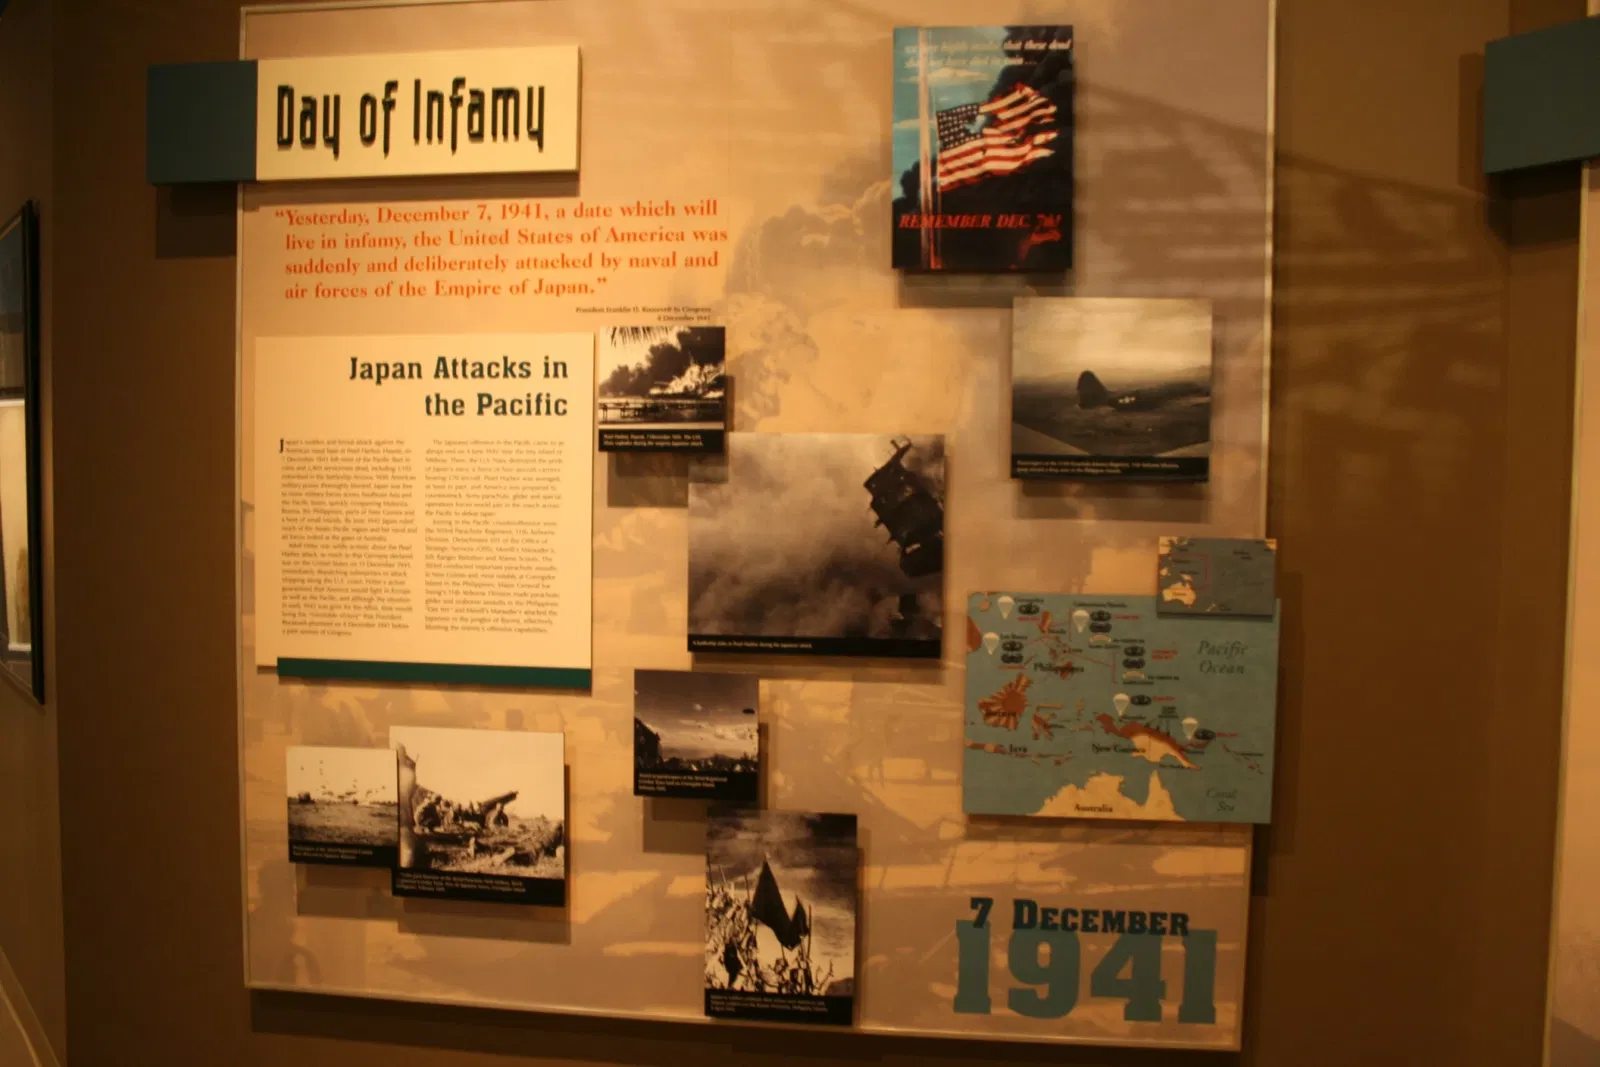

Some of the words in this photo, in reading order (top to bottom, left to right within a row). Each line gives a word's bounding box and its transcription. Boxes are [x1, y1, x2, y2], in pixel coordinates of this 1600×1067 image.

[276, 84, 341, 161] Day
[359, 80, 398, 159] of
[412, 76, 545, 156] Infamy
[377, 205, 471, 223] December
[477, 204, 493, 221] 7,
[500, 202, 550, 220] 1941,
[555, 206, 566, 218] a
[573, 202, 613, 218] date
[620, 200, 677, 217] which
[683, 199, 719, 216] will
[899, 213, 993, 229] REMEMBER
[286, 234, 316, 250] live
[321, 233, 338, 249] in
[345, 231, 408, 250] infamy,
[414, 230, 443, 247] the
[450, 228, 511, 246] United
[517, 228, 573, 244] States
[580, 226, 601, 243] of
[605, 225, 685, 243] America
[693, 229, 729, 242] was
[285, 257, 360, 276] suddenly
[367, 256, 399, 273] and
[404, 253, 510, 273] deliberately
[516, 251, 594, 270] attacked
[601, 252, 622, 272] by
[629, 251, 677, 268] naval
[684, 250, 719, 267] and
[285, 283, 309, 299] air
[315, 281, 368, 299] forces
[374, 280, 395, 297] of
[399, 279, 427, 296] the
[435, 278, 502, 298] Empire
[509, 278, 530, 295] of
[349, 357, 422, 385] Japan
[434, 356, 532, 379] Attacks
[543, 355, 568, 379] in
[425, 393, 465, 416] the
[476, 393, 568, 416] Pacific
[1198, 640, 1249, 660] Pacific
[1200, 660, 1246, 675] Ocean
[970, 897, 993, 928] 7
[953, 919, 1217, 1025] 1941
